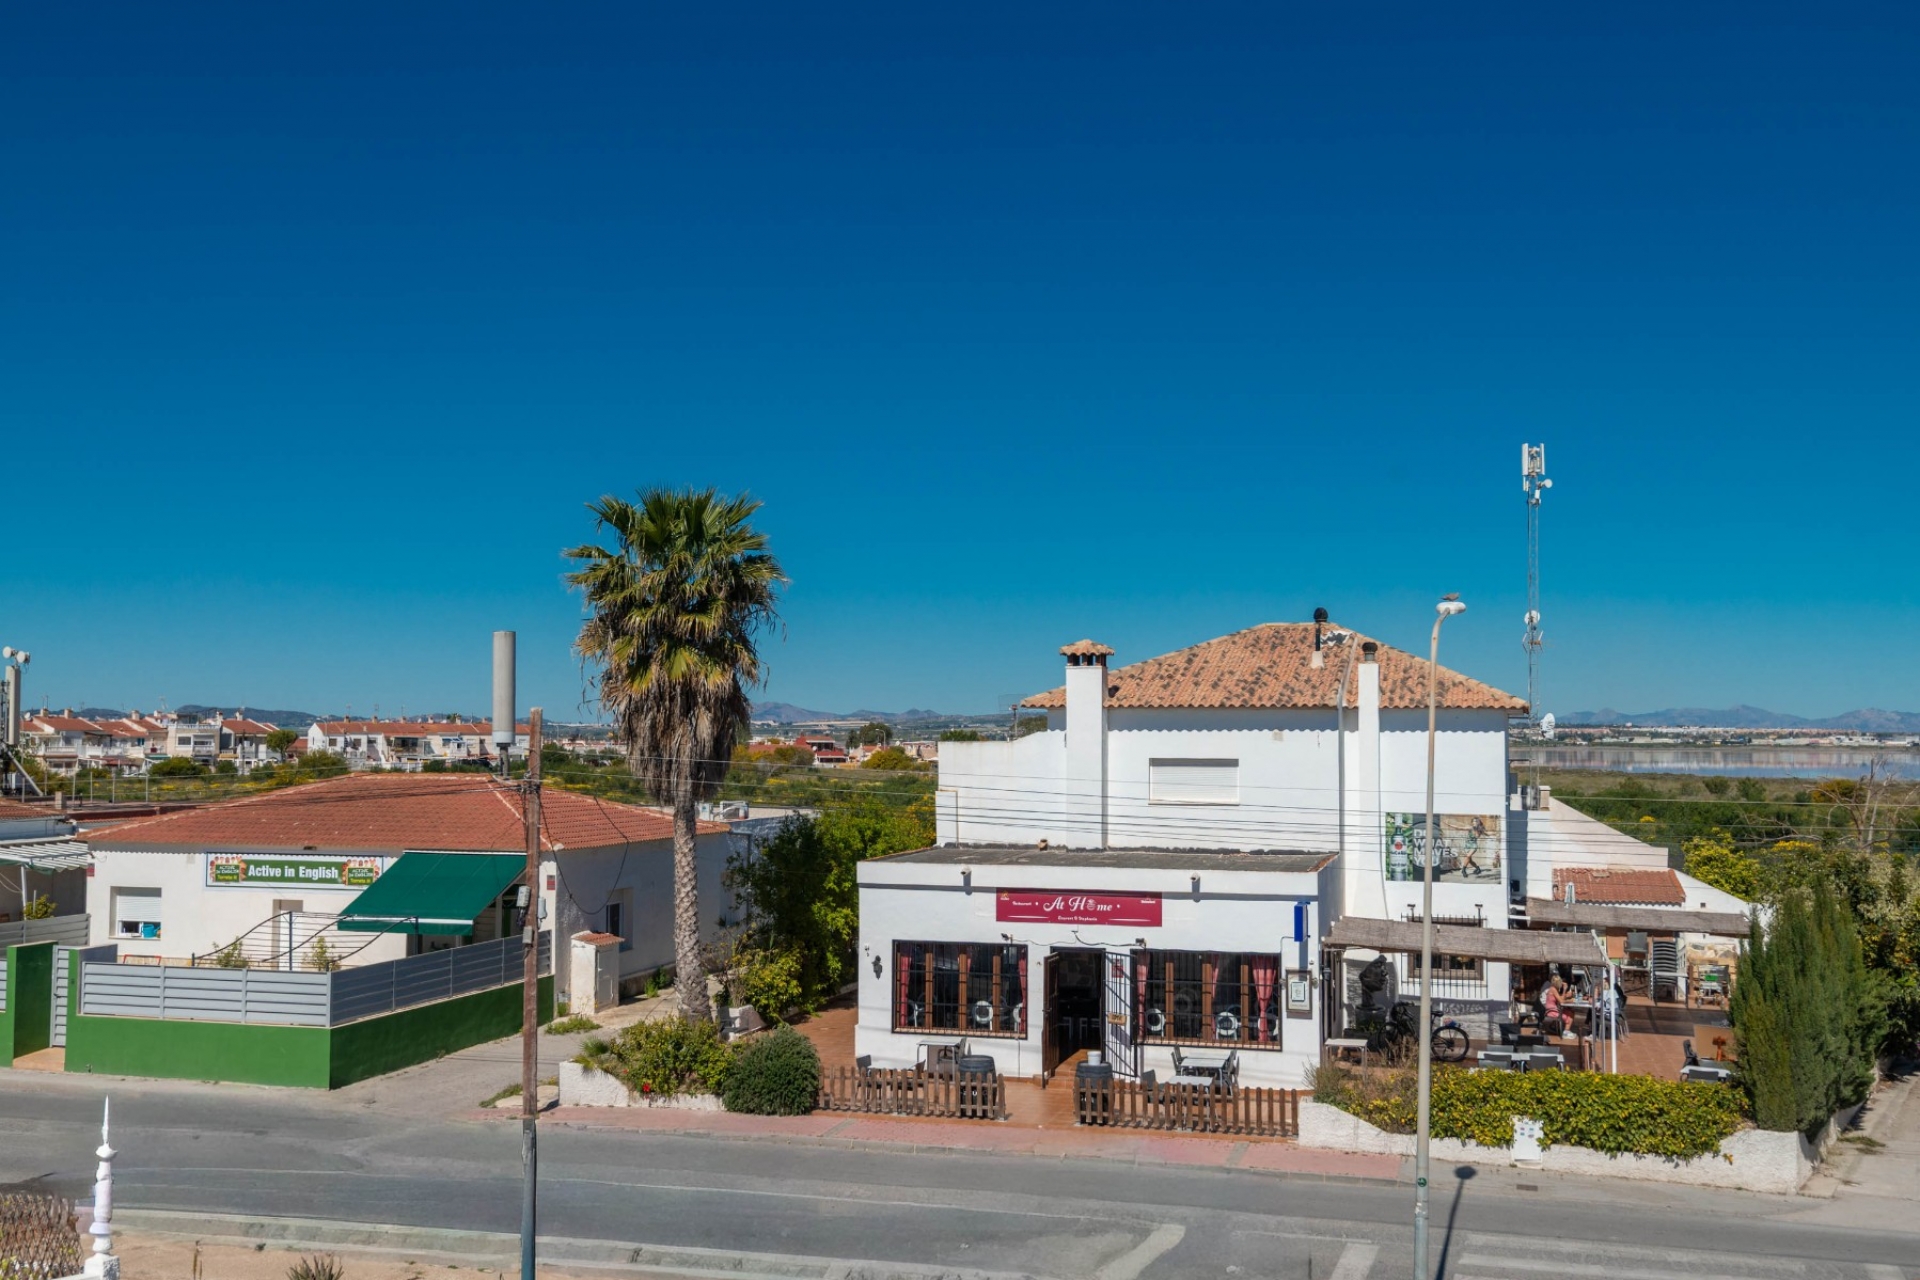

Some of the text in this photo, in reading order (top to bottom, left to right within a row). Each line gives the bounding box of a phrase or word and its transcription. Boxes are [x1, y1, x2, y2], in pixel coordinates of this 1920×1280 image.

[1414, 847, 1459, 857] MVES
[248, 864, 339, 880] Active in English
[1043, 896, 1065, 912] At
